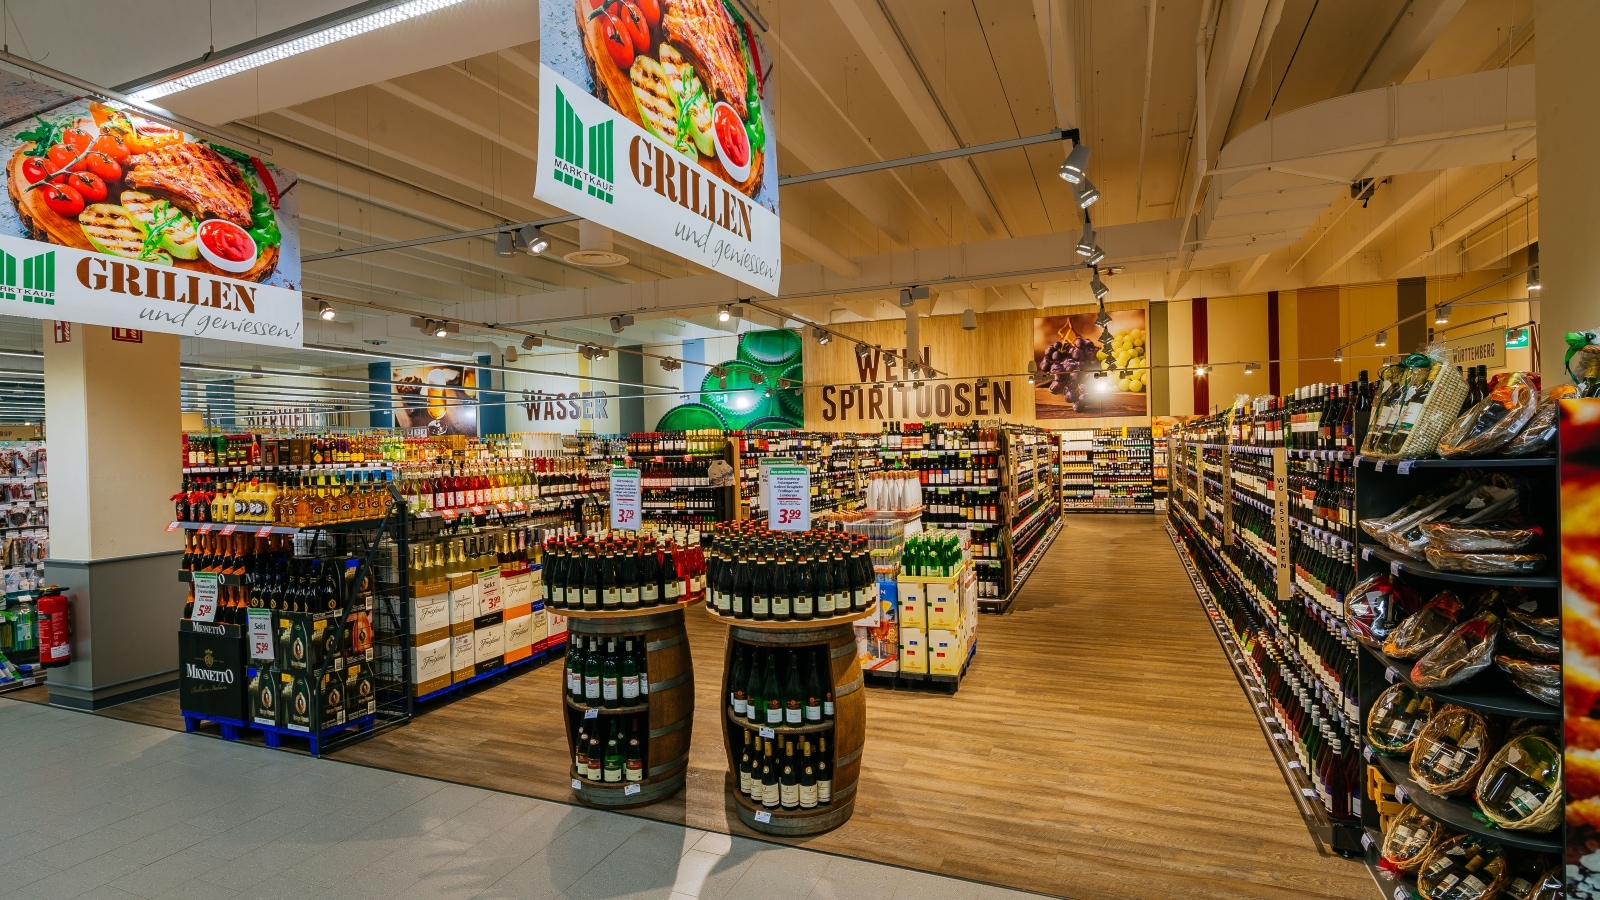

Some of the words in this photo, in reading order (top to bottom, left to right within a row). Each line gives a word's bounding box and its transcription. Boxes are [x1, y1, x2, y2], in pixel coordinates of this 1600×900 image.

[554, 158, 614, 192] MARKTKAUF
[629, 135, 753, 242] GRILLEN
[674, 221, 714, 254] und
[712, 238, 778, 282] geniessen!
[76, 256, 257, 314] GRILLEN
[140, 304, 196, 327] und
[194, 315, 300, 340] geniessen!
[854, 344, 931, 382] WEIN
[1452, 342, 1495, 364] WÜRTTEMBERG
[525, 390, 608, 421] WASSER
[822, 380, 1013, 422] SPIRITUOSEN
[1279, 500, 1287, 569] ESSLINGEN
[192, 622, 225, 635] MIONETTO
[186, 663, 234, 684] MIONETTO
